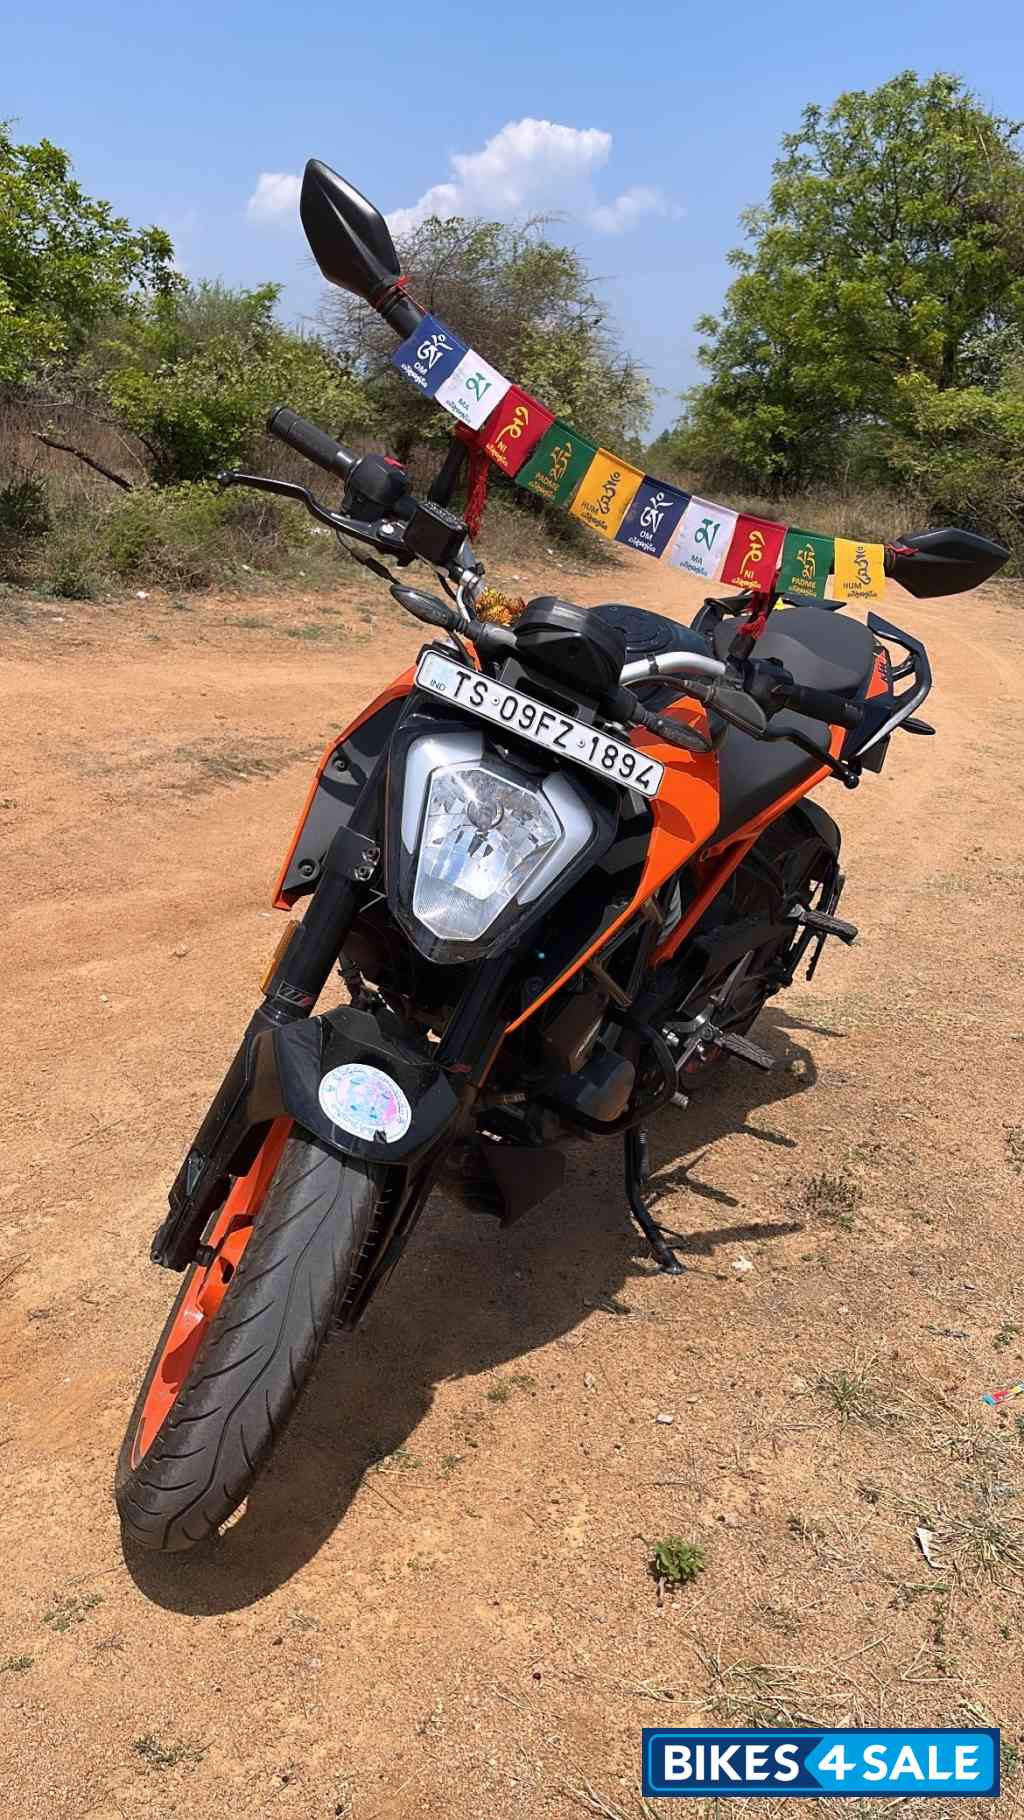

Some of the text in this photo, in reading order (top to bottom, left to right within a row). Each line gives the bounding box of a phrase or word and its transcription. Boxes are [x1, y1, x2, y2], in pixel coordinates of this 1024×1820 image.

[414, 362, 428, 375] OM
[640, 530, 653, 541] OM
[691, 554, 703, 565] MA
[744, 570, 754, 579] NI
[843, 582, 862, 590] HUM
[430, 679, 447, 691] IND
[454, 670, 488, 706] TS
[588, 736, 654, 790] 1894
